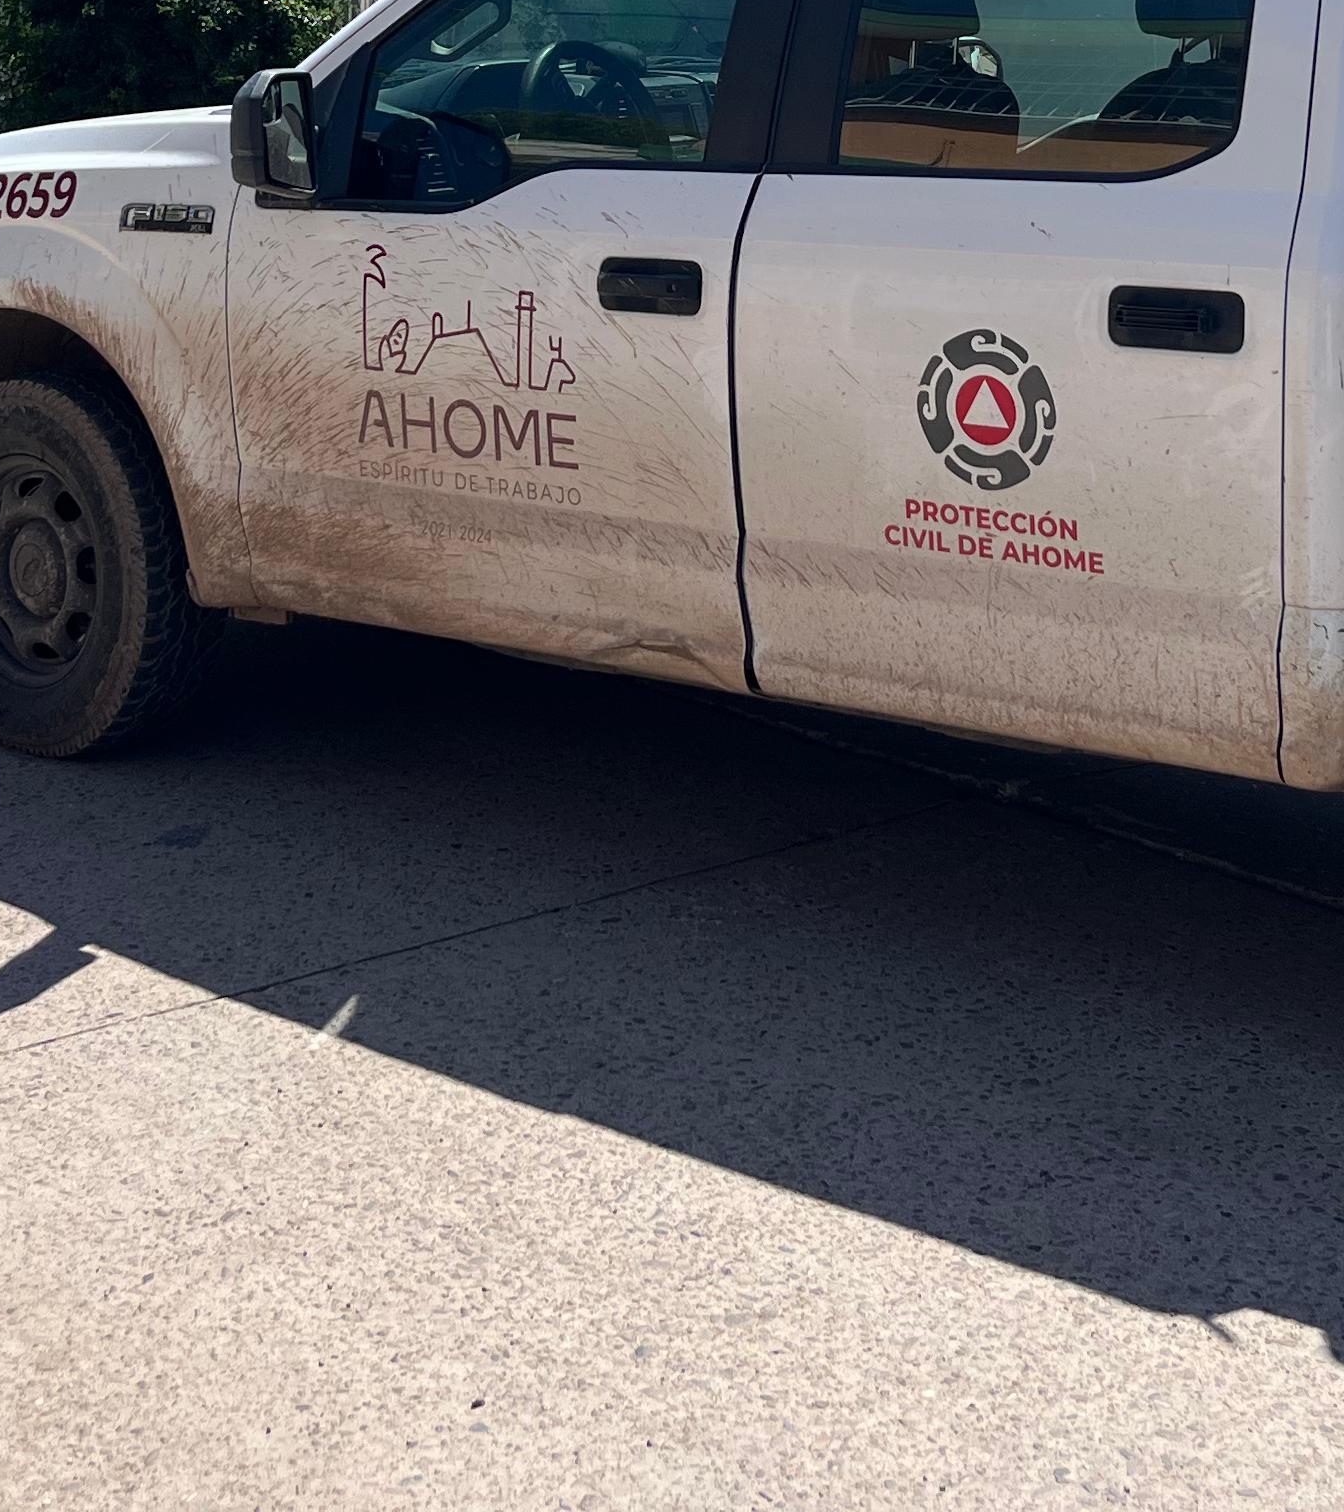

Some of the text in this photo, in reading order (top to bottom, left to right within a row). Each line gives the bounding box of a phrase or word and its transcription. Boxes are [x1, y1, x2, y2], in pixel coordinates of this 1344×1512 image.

[358, 389, 579, 470] AHOME
[359, 460, 582, 506] ESPÍRITU DE TRABAJO
[421, 520, 493, 543] 2021 2024
[905, 498, 1078, 541] PROTECCIÓN
[884, 524, 1104, 575] CIVIL DE AHOME
